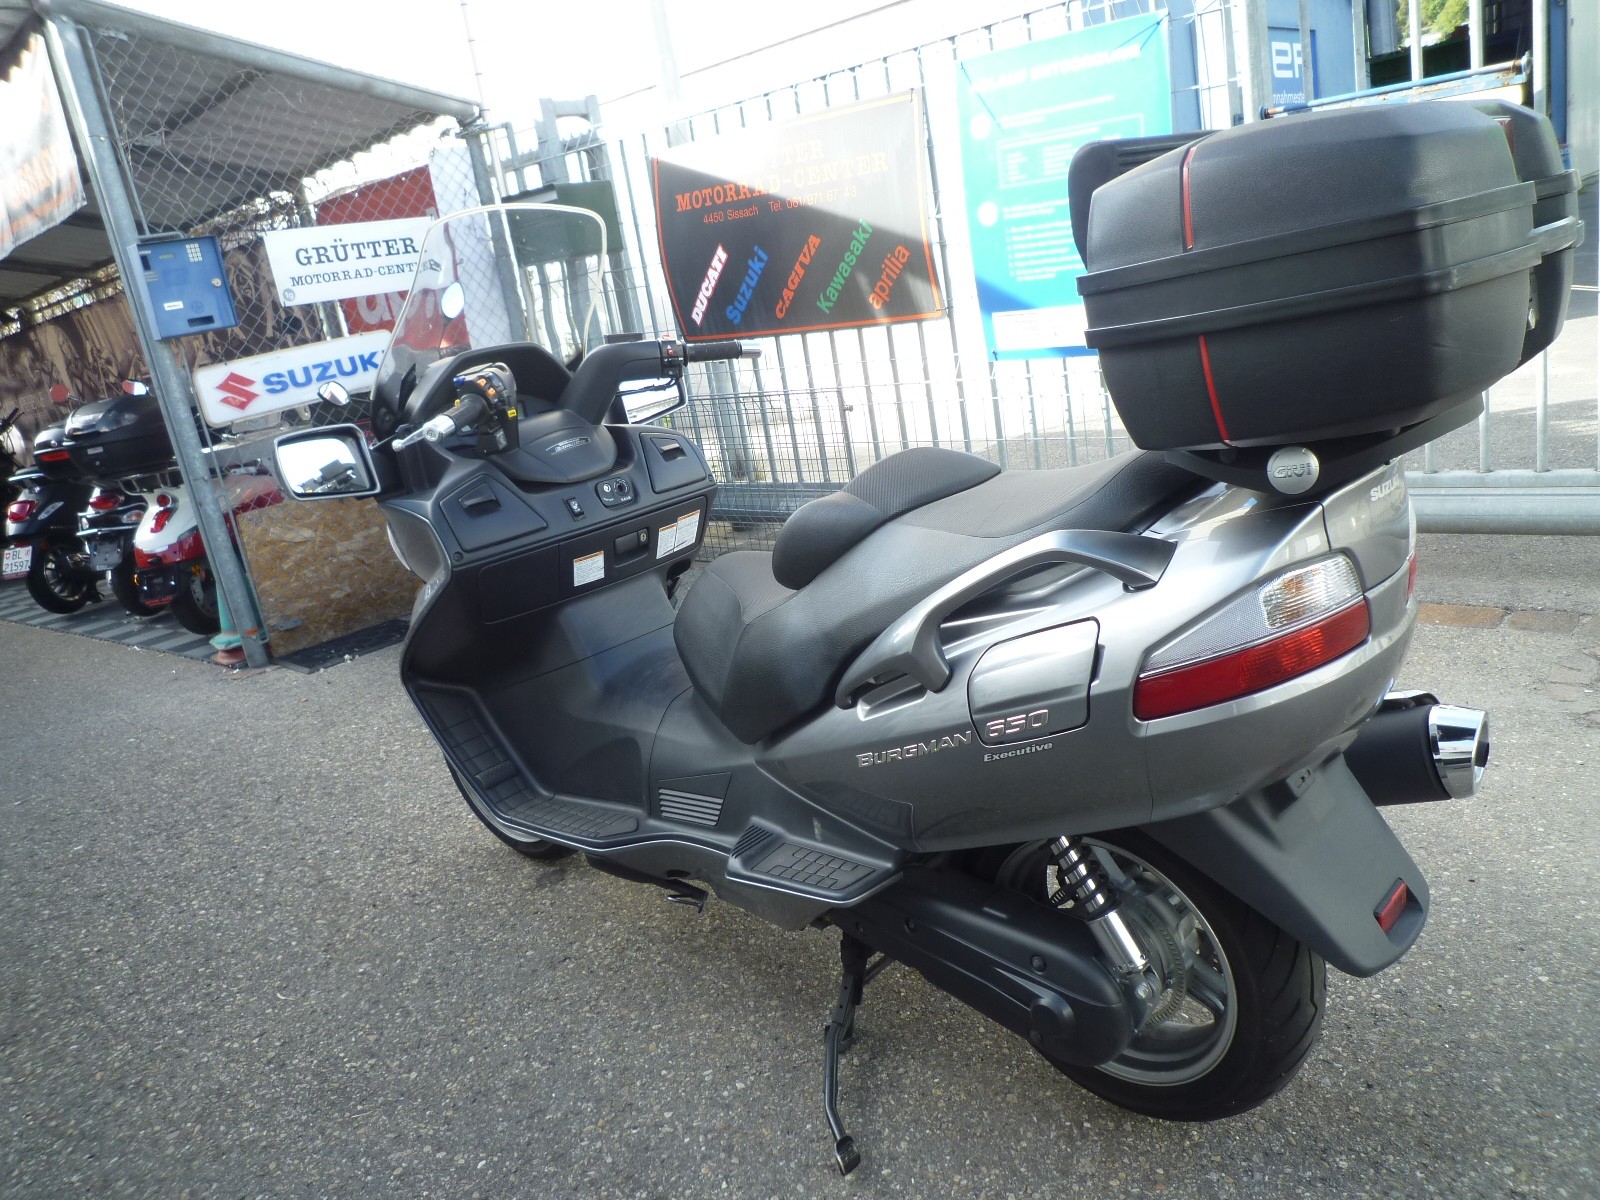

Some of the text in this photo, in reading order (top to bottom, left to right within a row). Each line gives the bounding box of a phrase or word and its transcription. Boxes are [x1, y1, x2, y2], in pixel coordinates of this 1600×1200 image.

[676, 151, 889, 212] MOTORRAD-CENTER
[703, 211, 724, 224] 4450
[727, 204, 759, 220] Sissach
[295, 236, 419, 266] GRÜTTER
[775, 233, 821, 320] CAGIVA
[816, 218, 873, 315] Kawasaki
[691, 243, 729, 326] DUCATI
[726, 245, 769, 326] Suzuki
[868, 245, 910, 310] aprilia
[262, 350, 385, 394] SUZUK
[12, 550, 22, 560] BL
[984, 708, 1049, 739] 650
[983, 742, 1054, 763] Executive
